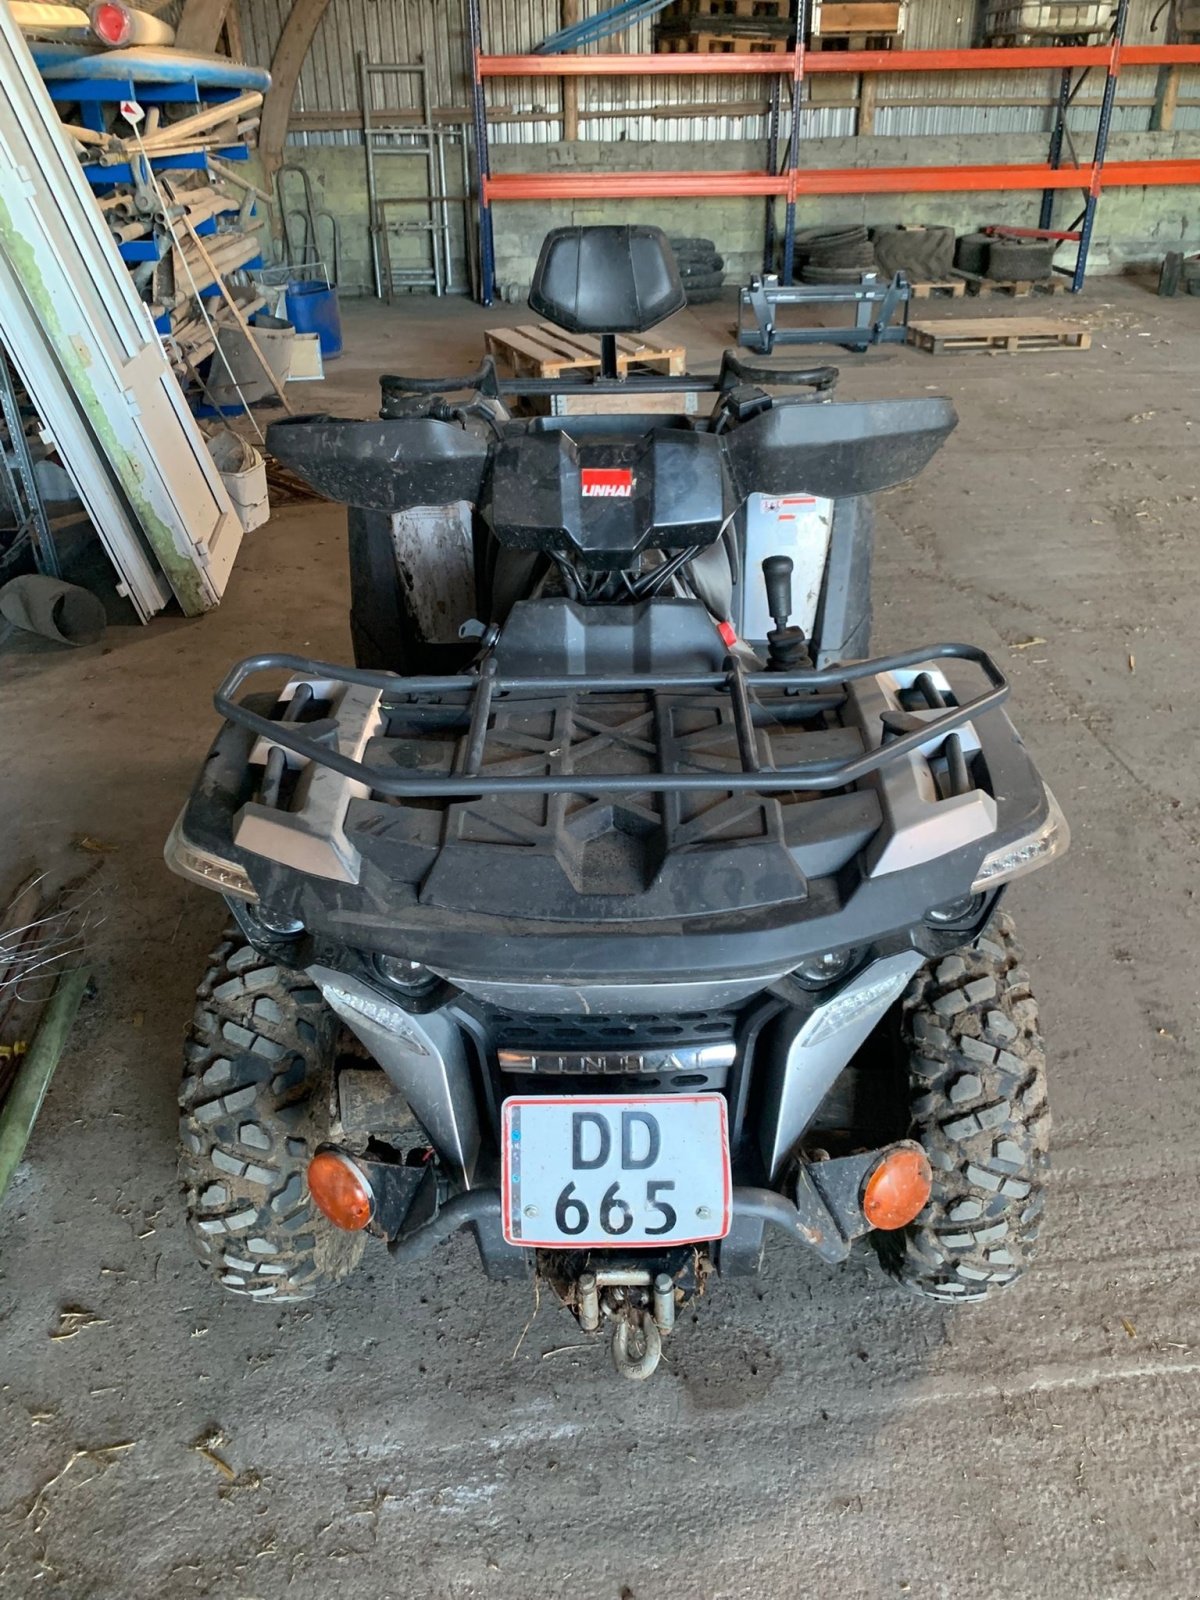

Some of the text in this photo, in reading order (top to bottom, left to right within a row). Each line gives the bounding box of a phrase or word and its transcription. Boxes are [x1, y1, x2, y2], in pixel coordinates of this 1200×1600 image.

[582, 484, 631, 497] LINHAI
[531, 1052, 703, 1073] LINHAI
[572, 1111, 661, 1170] DD
[555, 1181, 677, 1235] 665
